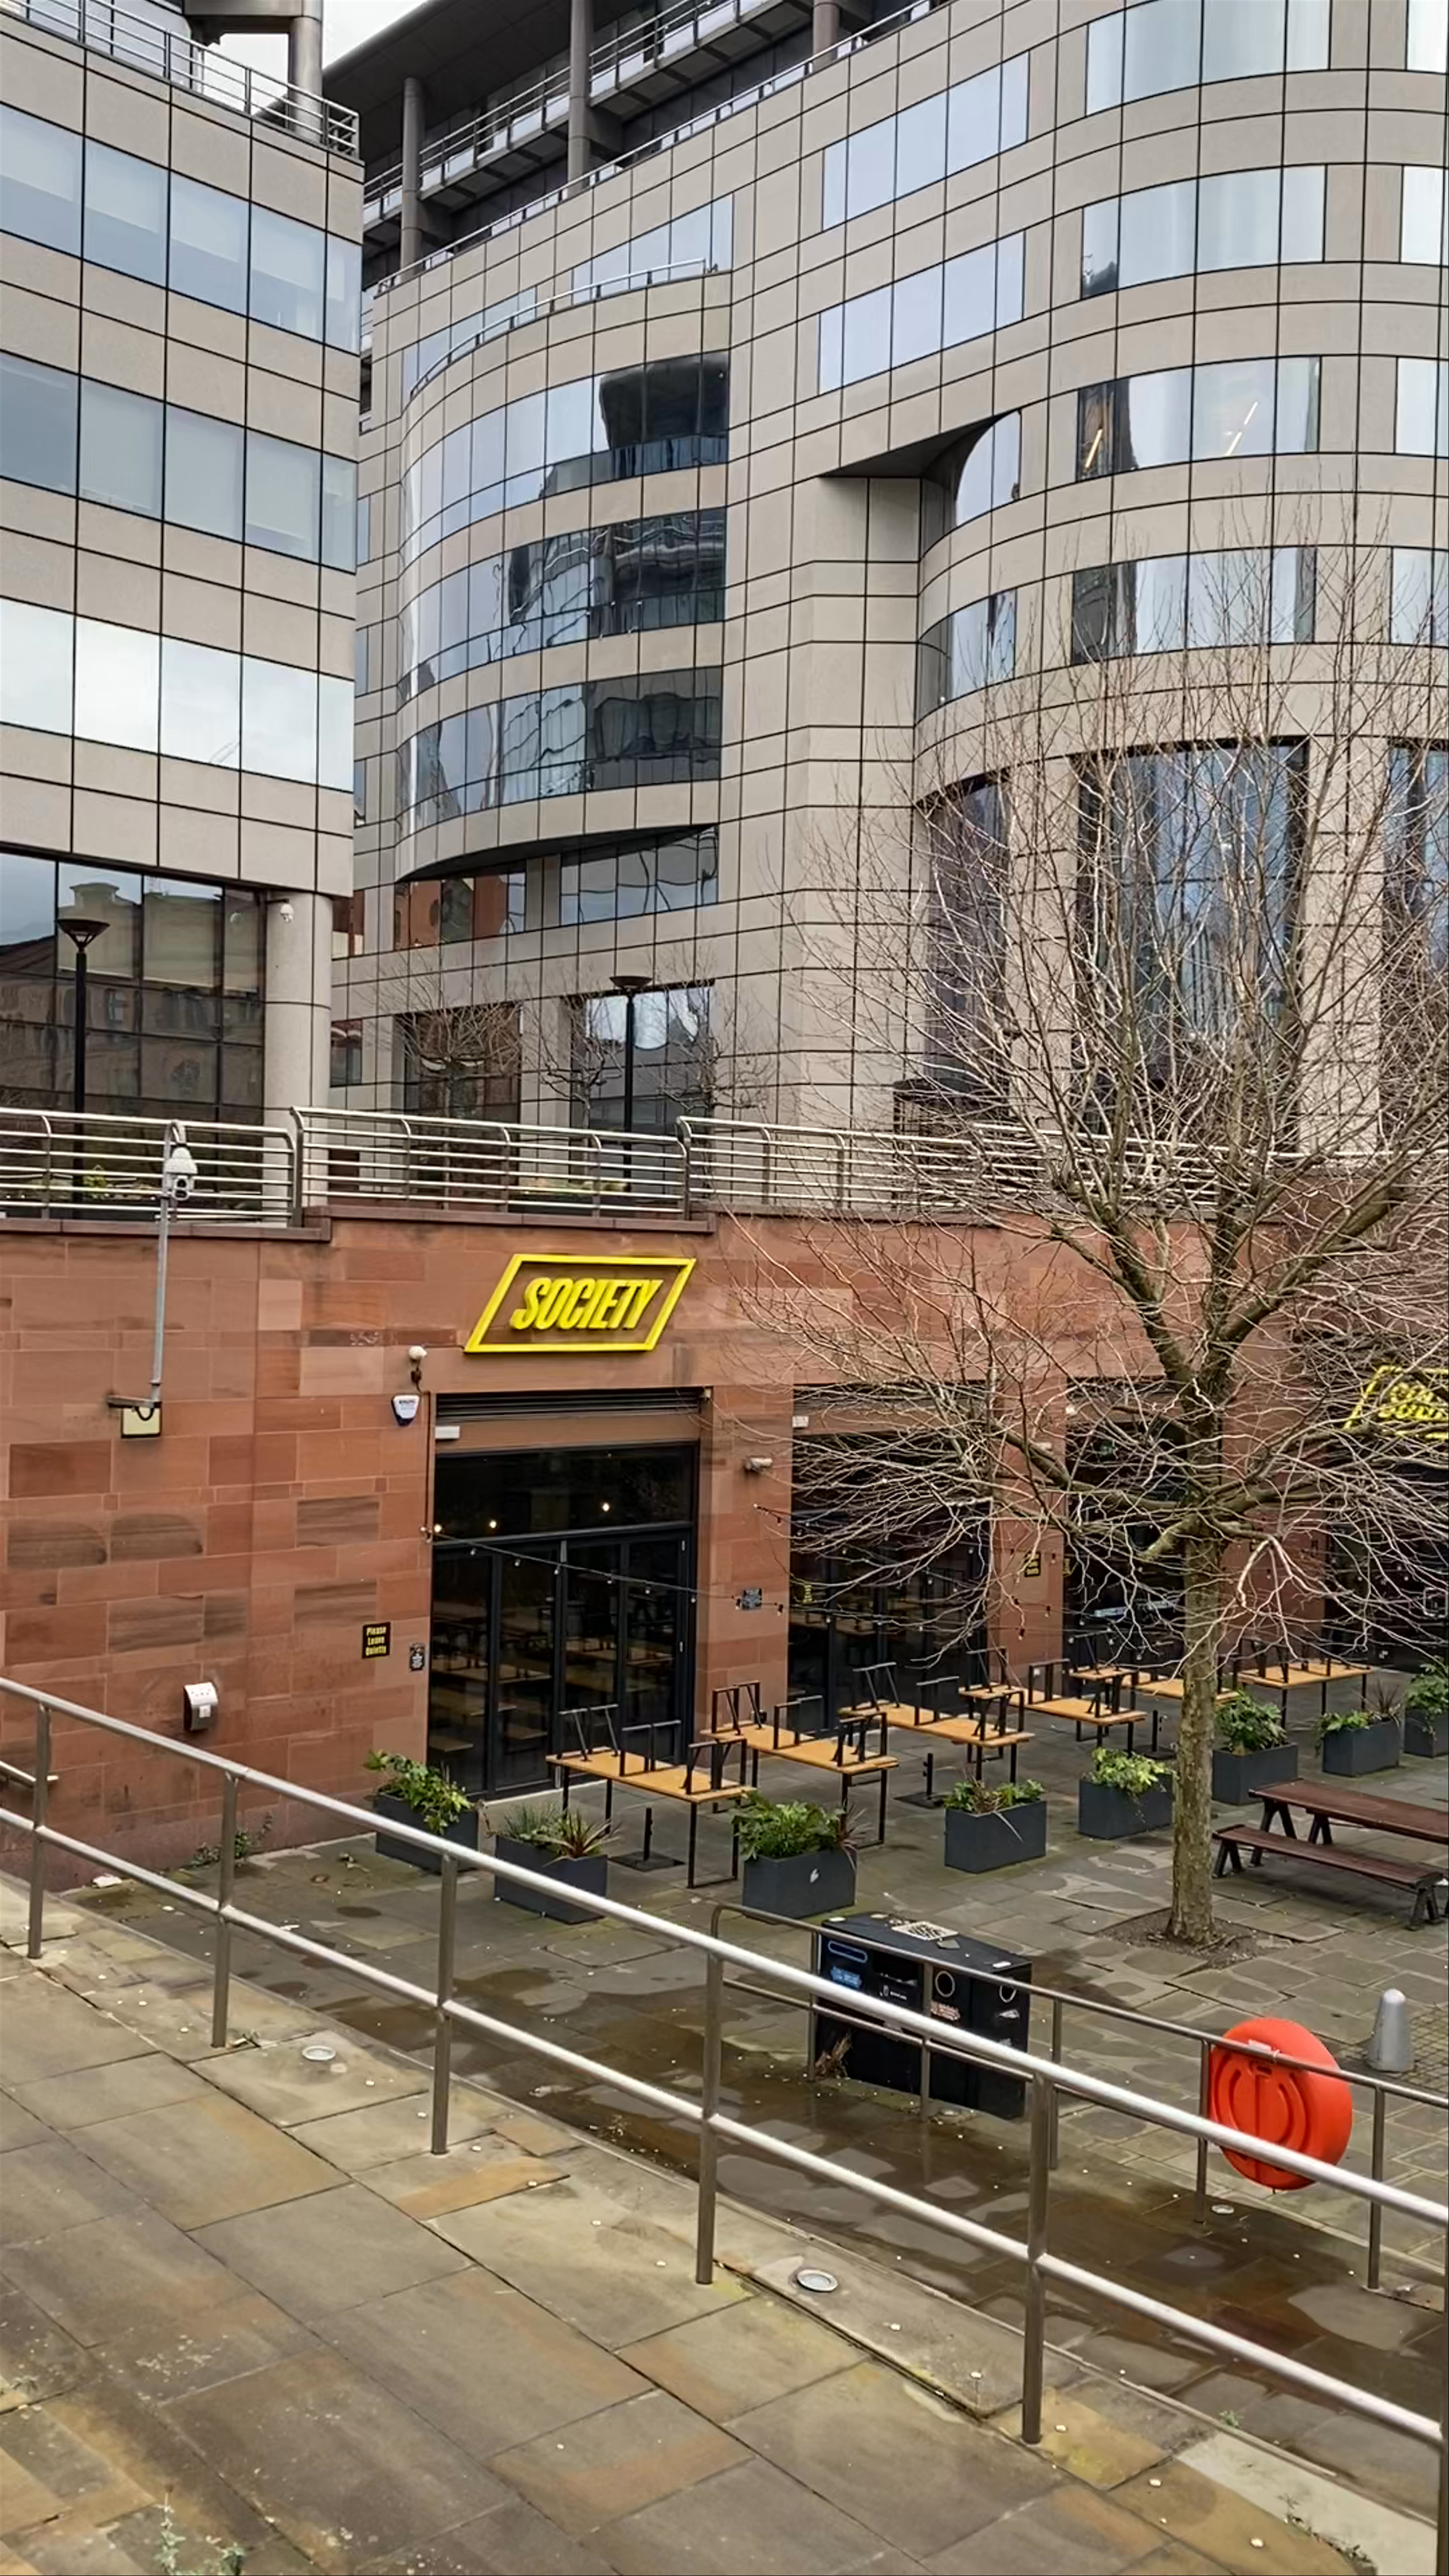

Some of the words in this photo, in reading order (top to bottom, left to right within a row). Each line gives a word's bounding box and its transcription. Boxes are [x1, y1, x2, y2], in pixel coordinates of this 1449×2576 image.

[509, 1277, 664, 1330] SOCIETY
[367, 1627, 386, 1636] Please
[368, 1636, 385, 1646] Leave
